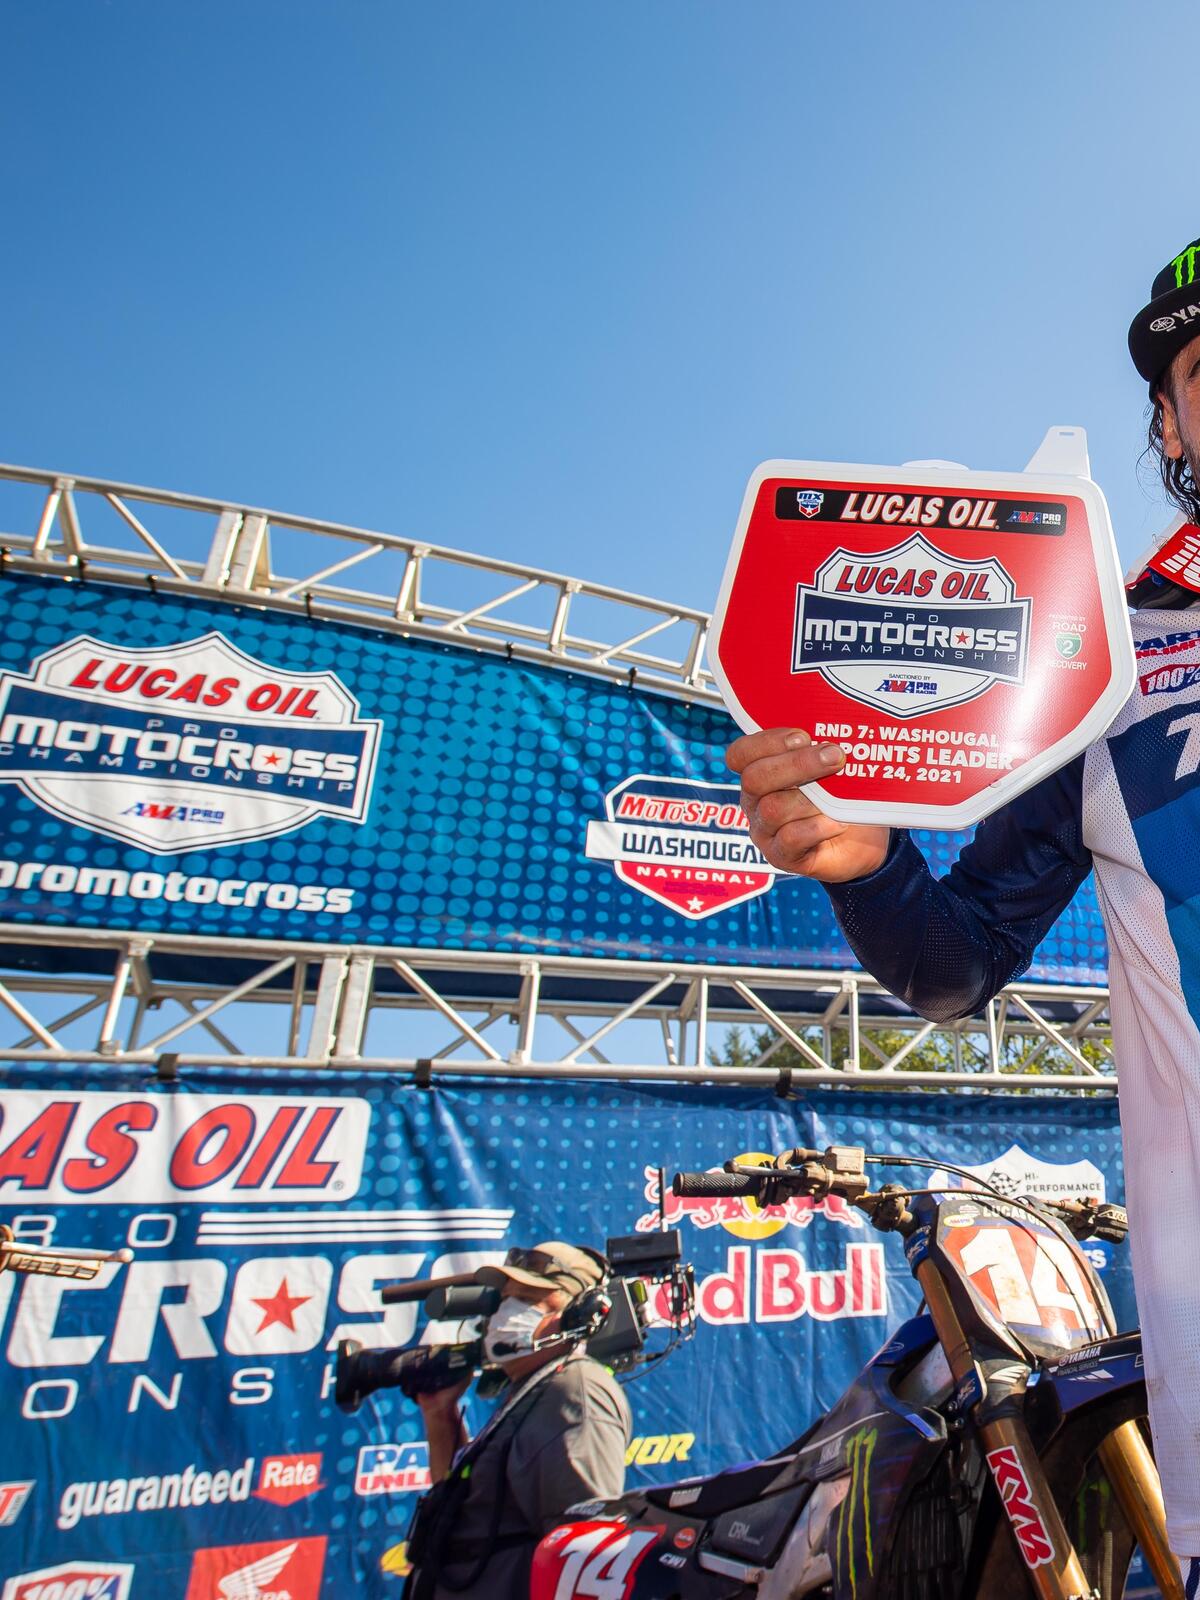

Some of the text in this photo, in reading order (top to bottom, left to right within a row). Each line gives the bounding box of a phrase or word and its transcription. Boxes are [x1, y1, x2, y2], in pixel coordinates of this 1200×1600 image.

[839, 492, 998, 528] LUCAS OIL
[1042, 513, 1061, 522] PRO
[834, 564, 991, 600] LUCAS OIL
[883, 611, 939, 623] PRO
[1051, 621, 1087, 633] ROAD
[804, 618, 1019, 652] MOTOCROSS
[803, 641, 1017, 663] CHAMPIONSHIP
[1062, 639, 1074, 655] 2
[1049, 660, 1087, 670] ECOVERY
[875, 679, 938, 694] AMA PRO
[888, 673, 923, 681] SANCTIONED
[70, 658, 322, 720] LUCAS OIL
[146, 718, 239, 741] PRO
[815, 722, 1000, 747] RND 7: WASHOUGAL
[0, 714, 360, 782] MOTOCROSS
[839, 742, 1014, 770] POINTS LEADER
[0, 743, 354, 793] CHAMPIONSHIP
[883, 766, 912, 782] 24,
[916, 768, 962, 783] 2021
[191, 807, 225, 820] PRO
[636, 866, 756, 884] NATIONAL
[168, 1102, 344, 1192] OIL
[1026, 1182, 1101, 1193] PERFORMANCE
[758, 1245, 885, 1321] Bull
[957, 1226, 1100, 1340] 14
[1068, 1346, 1102, 1364] YAMAHA
[56, 1458, 318, 1530] guaranteed Rate
[552, 1526, 659, 1600] 14
